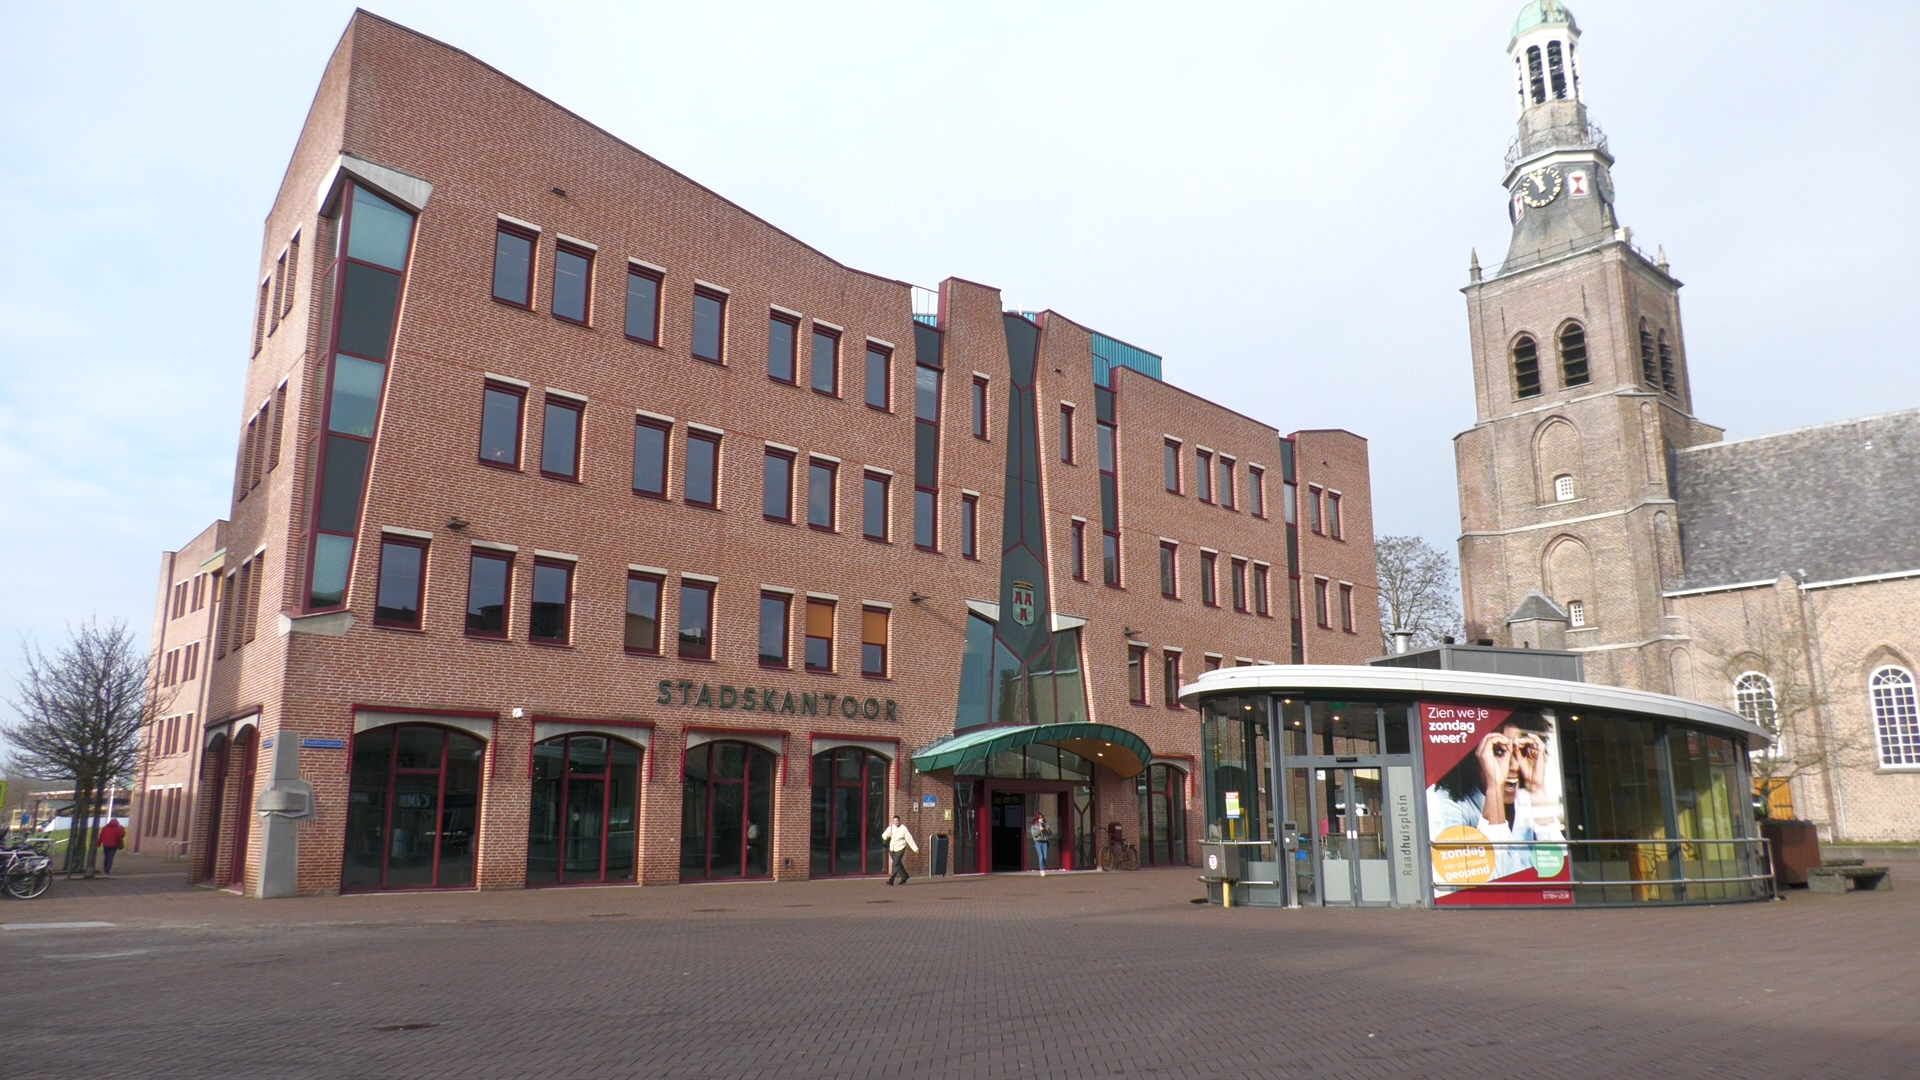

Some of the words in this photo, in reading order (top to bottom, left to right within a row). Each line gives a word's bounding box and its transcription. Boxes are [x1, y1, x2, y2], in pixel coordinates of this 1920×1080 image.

[657, 679, 897, 721] STADSKANTOOR
[1427, 707, 1455, 719] Zien
[1456, 709, 1475, 719] we
[1476, 707, 1489, 721] je
[1428, 720, 1475, 733] zondag
[1429, 732, 1468, 743] weer?
[1397, 795, 1413, 876] Raadhuisplein
[1440, 845, 1486, 860] zondag
[1445, 865, 1490, 881] geopend
